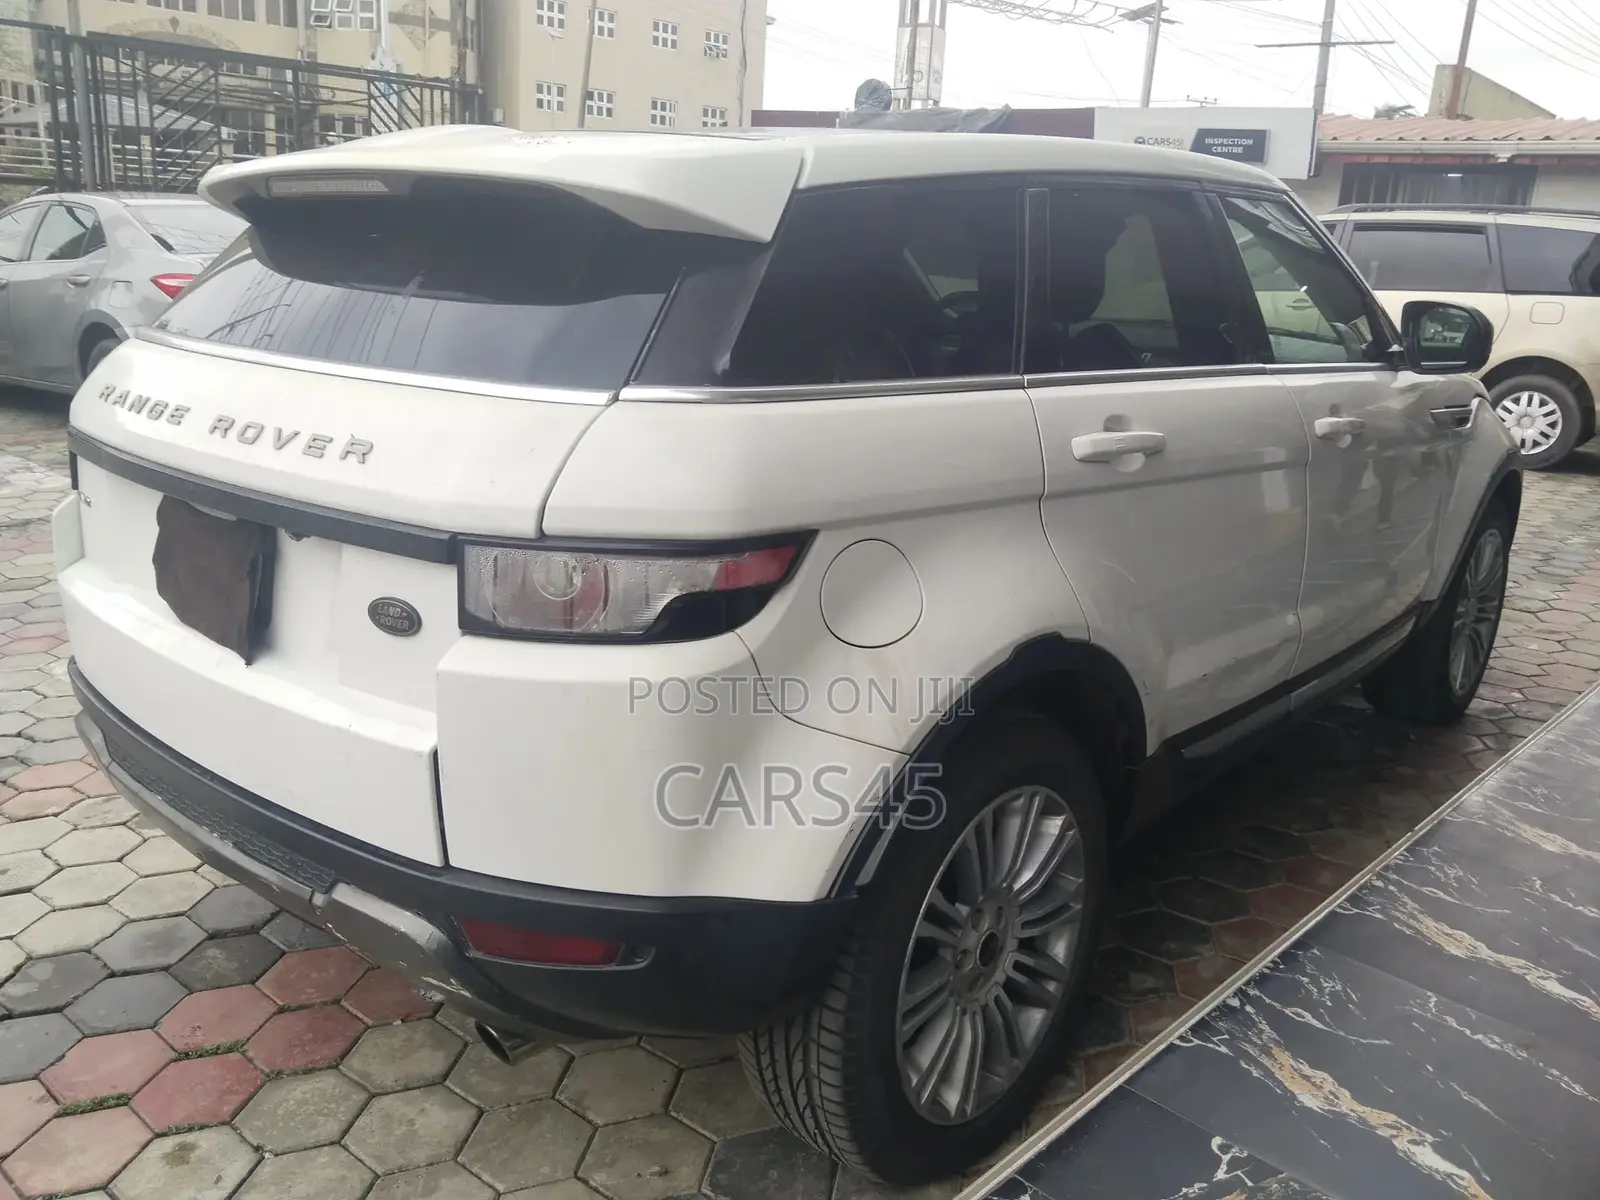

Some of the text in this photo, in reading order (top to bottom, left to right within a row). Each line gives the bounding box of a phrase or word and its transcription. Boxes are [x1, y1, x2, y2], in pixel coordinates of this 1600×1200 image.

[1204, 137, 1254, 145] INSPECTION
[98, 383, 374, 464] RANGE ROVER
[377, 603, 402, 618] LAND
[379, 614, 410, 630] ROVER
